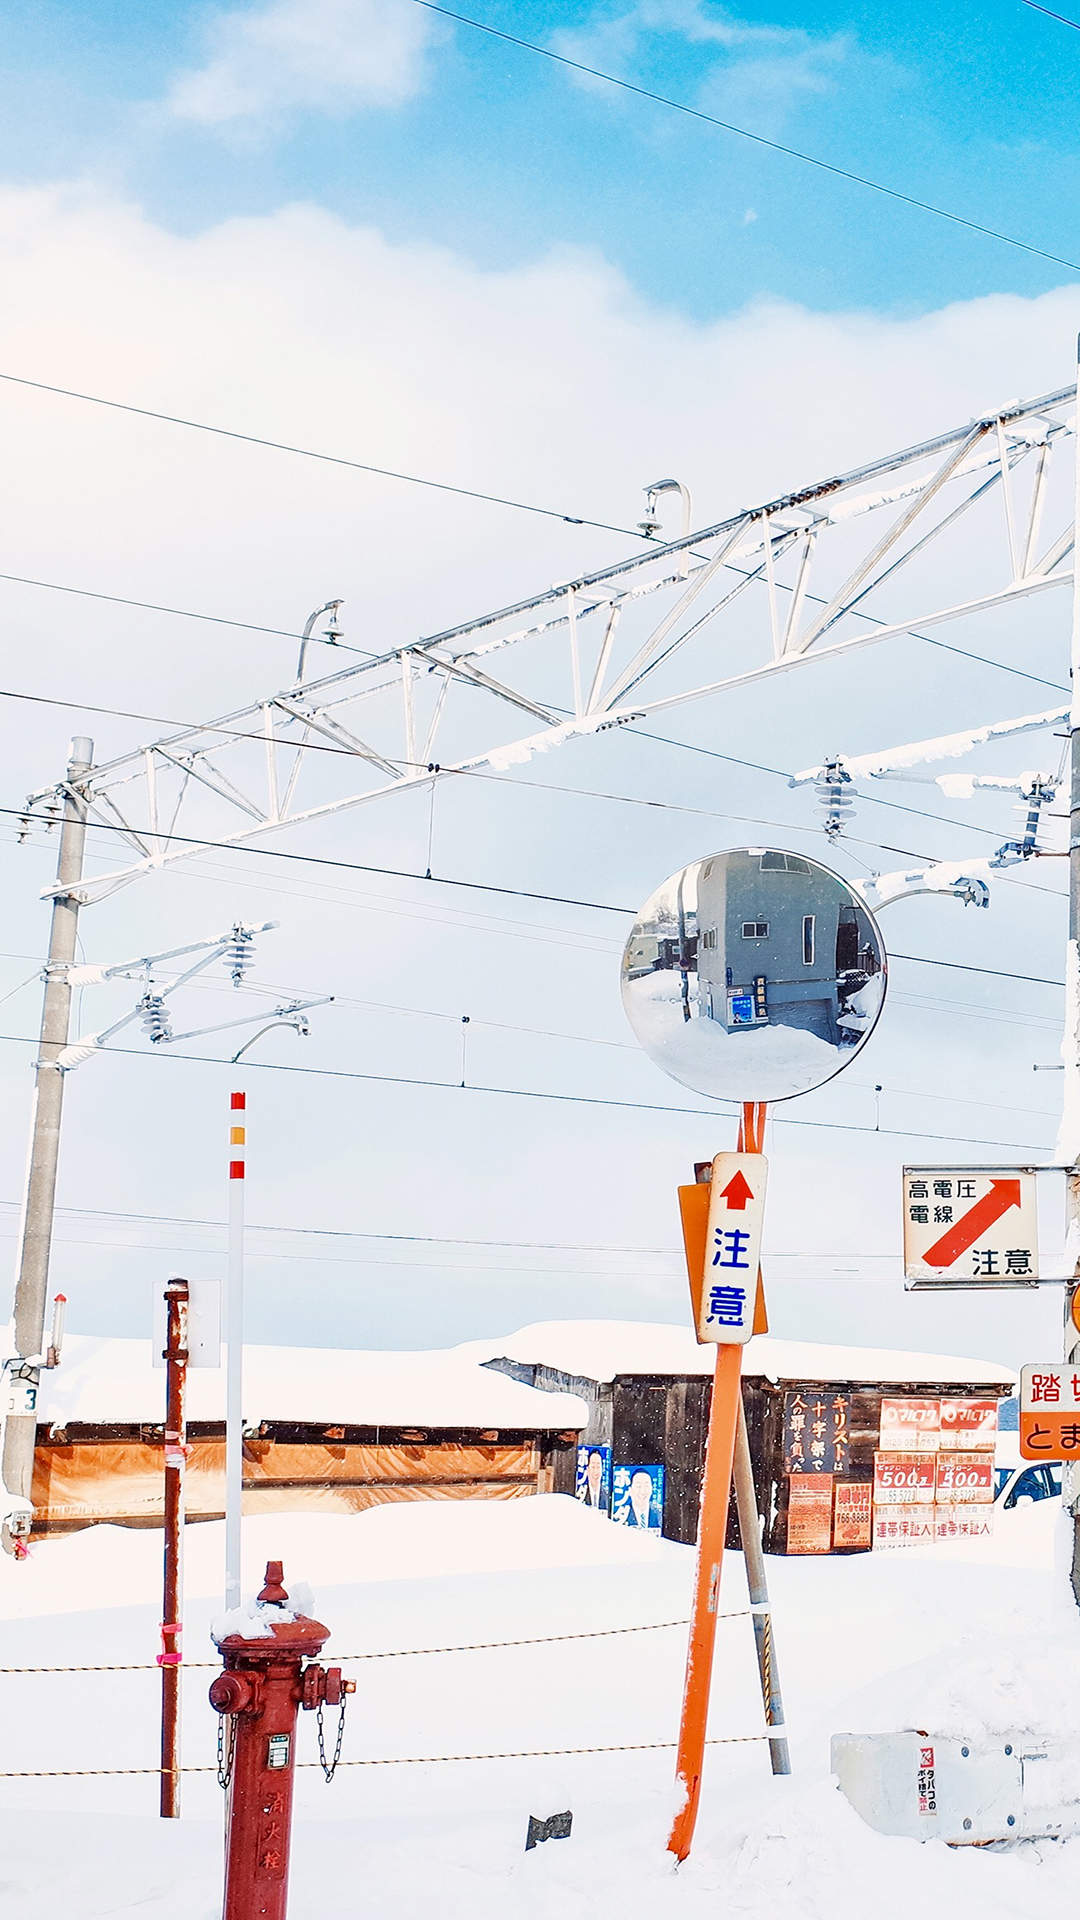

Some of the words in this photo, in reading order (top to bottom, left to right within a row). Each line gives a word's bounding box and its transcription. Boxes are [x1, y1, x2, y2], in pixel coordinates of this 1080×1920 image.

[908, 1179, 977, 1199] 高電圧
[909, 1204, 954, 1224] 電線
[706, 1227, 751, 1327] 注意
[972, 1249, 1033, 1276] 注意
[789, 1394, 809, 1473] 人の罪を負った
[811, 1401, 828, 1471] 十字架で
[832, 1396, 849, 1472] キリストは
[876, 1521, 932, 1538] 連帯保証人
[937, 1521, 991, 1537] 連帯保証人
[263, 1791, 286, 1871] 消火栓
